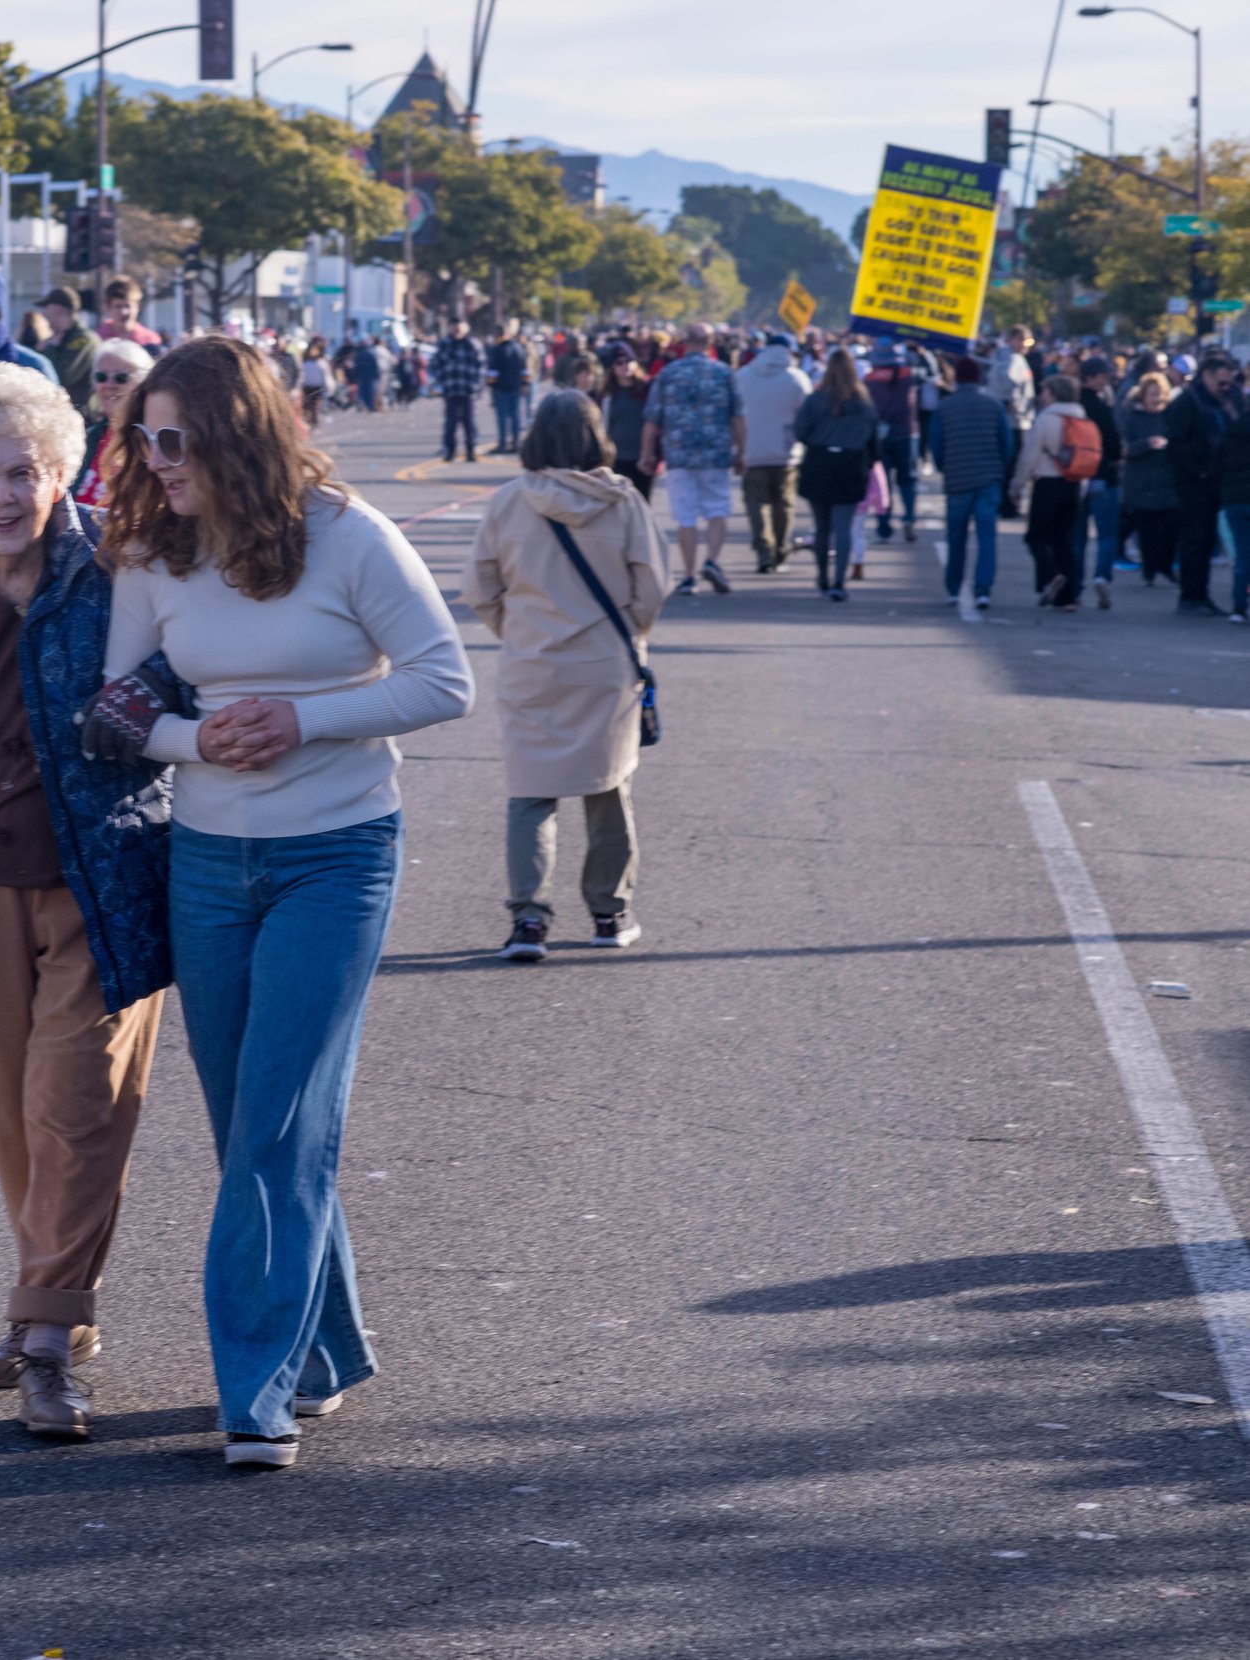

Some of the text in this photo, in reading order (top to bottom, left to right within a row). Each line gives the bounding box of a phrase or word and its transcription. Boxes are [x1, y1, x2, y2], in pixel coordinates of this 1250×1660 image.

[881, 171, 945, 196] RECEIVED
[928, 208, 961, 226] THEM
[885, 217, 977, 245] GOD GAVE THE
[871, 246, 927, 266] CHILDREN
[931, 257, 943, 270] OF
[875, 231, 981, 263] RIGHT TO BECOME
[912, 272, 945, 290] THOSE
[877, 283, 959, 309] WHO BELIEVED
